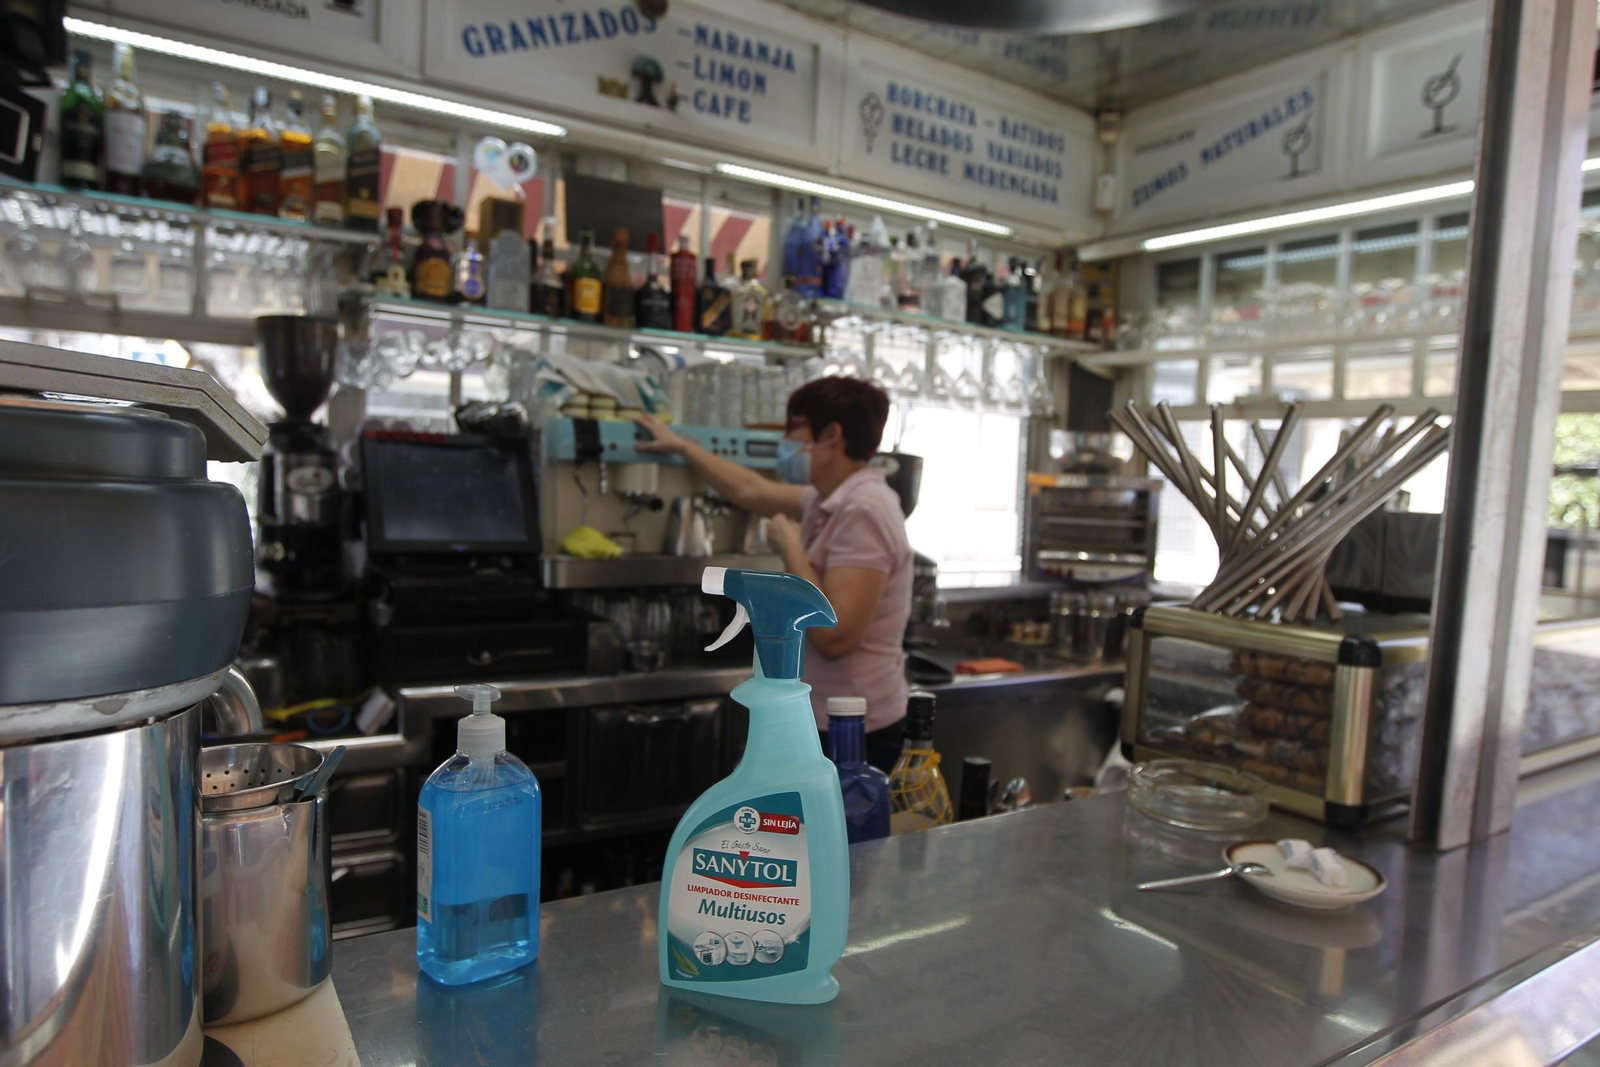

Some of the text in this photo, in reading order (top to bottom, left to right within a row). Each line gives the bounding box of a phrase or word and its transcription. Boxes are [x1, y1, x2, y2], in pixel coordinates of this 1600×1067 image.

[763, 819, 797, 829] SIN LEJÍA
[721, 840, 730, 849] El
[731, 840, 751, 850] Gesto
[695, 853, 793, 882] SANYTOL
[687, 884, 800, 906] LIMPIADOR DESINFECTANTE
[698, 899, 786, 925] Multiusos
